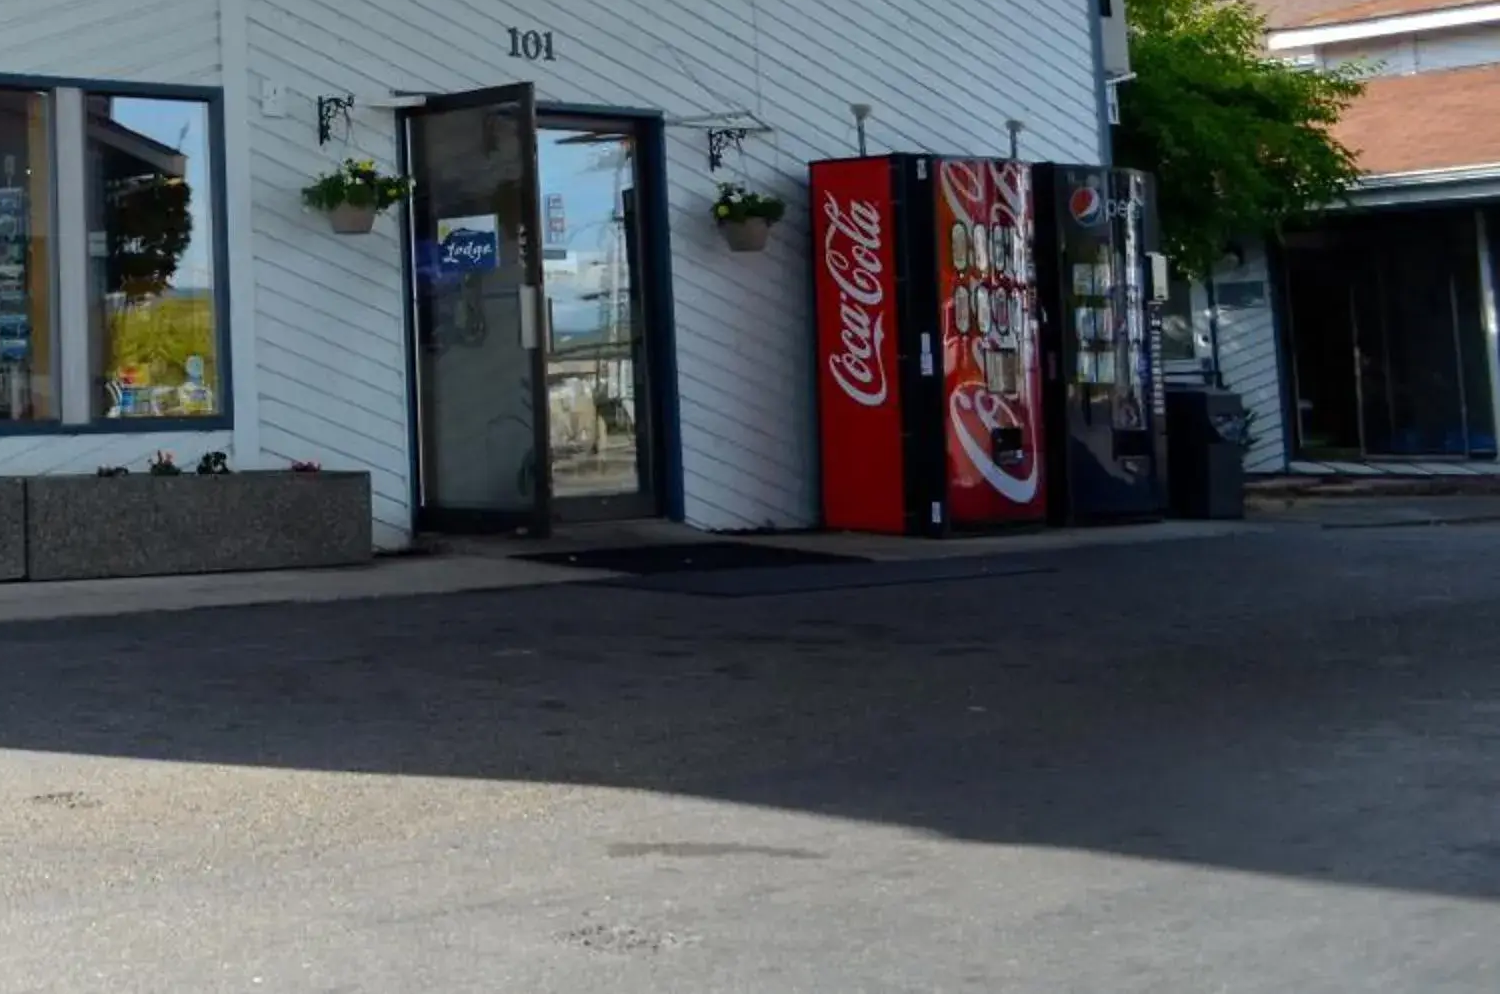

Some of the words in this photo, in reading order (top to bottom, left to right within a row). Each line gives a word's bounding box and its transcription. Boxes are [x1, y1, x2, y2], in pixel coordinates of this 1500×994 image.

[508, 26, 557, 62] 101
[443, 241, 493, 264] Lodge
[823, 189, 888, 406] Coca-Cola
